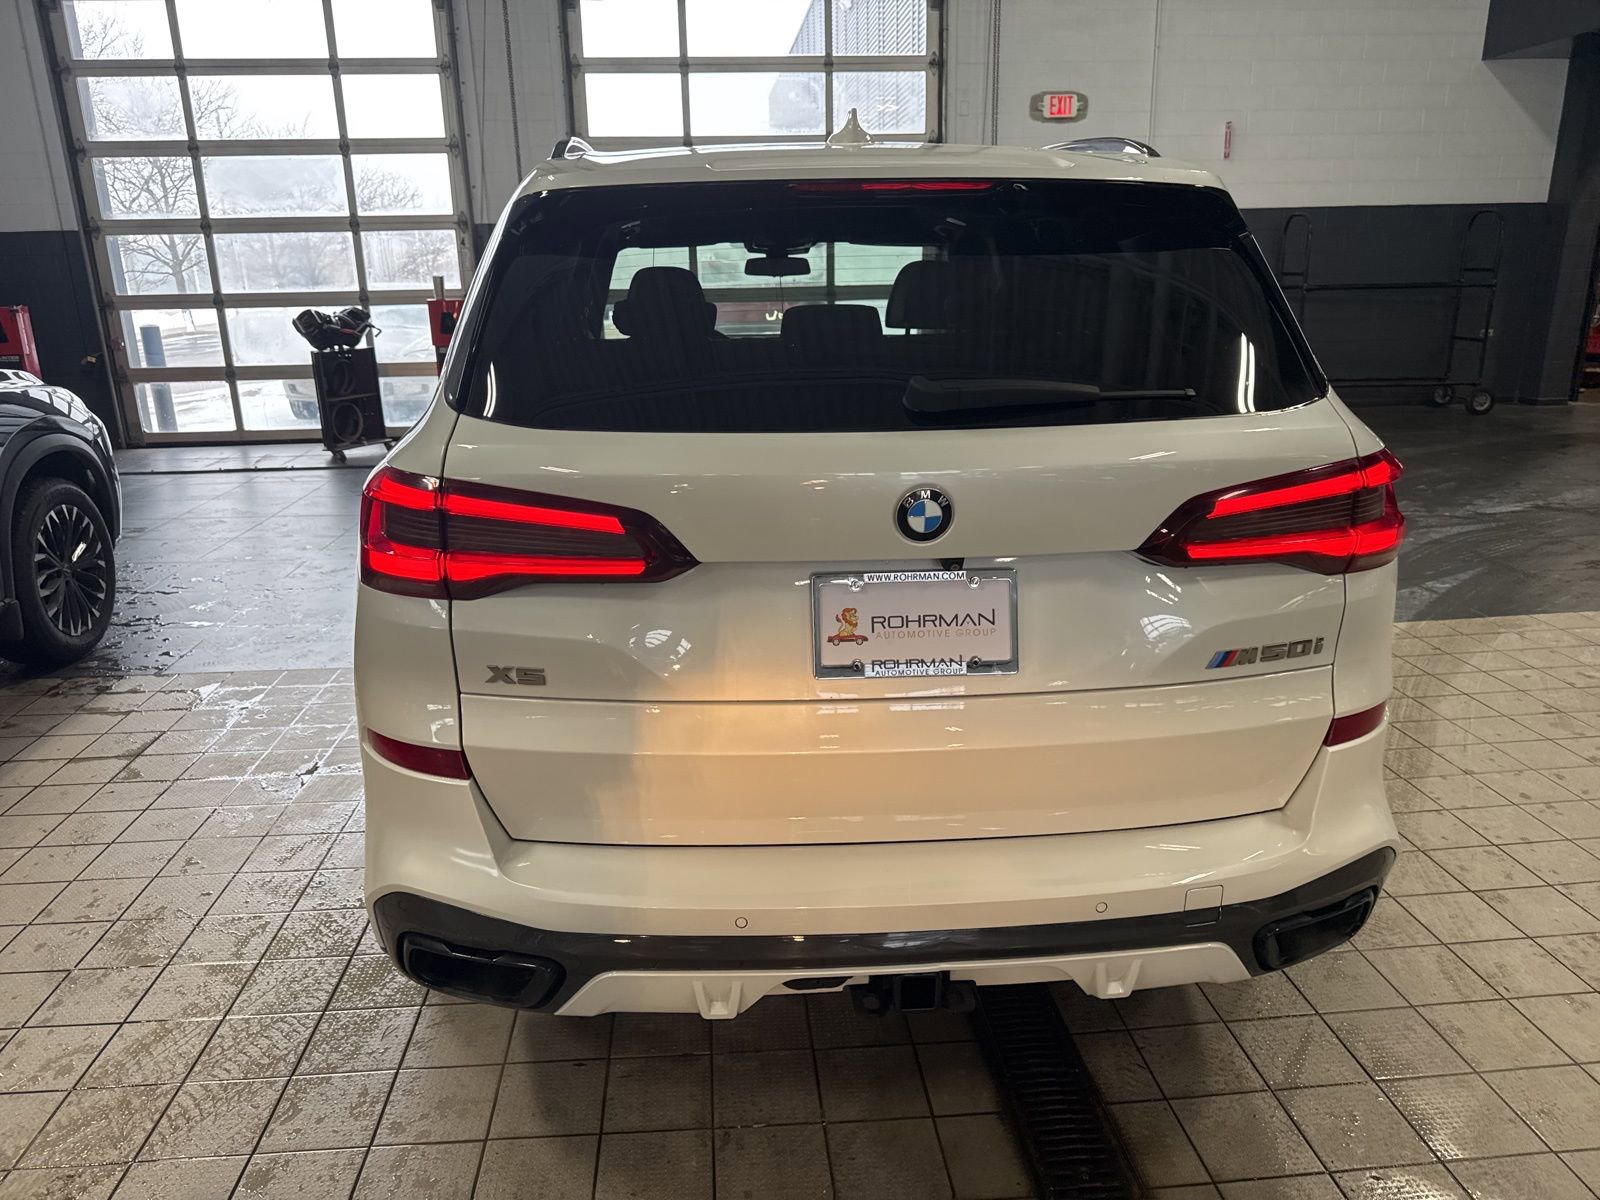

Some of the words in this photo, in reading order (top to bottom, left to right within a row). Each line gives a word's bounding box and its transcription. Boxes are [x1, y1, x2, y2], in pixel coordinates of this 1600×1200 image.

[1050, 95, 1073, 116] EXIT
[903, 490, 949, 508] BMW
[867, 571, 965, 582] WWW.ROHRMAN.COM
[871, 608, 996, 634] ROHRMAN
[875, 629, 951, 640] AUTOMOTIVE
[955, 628, 997, 637] GROUP
[871, 654, 963, 673] ROHRMAN
[875, 668, 932, 677] AUTOMOTIVE
[933, 667, 964, 676] GROUP
[485, 665, 546, 686] X5
